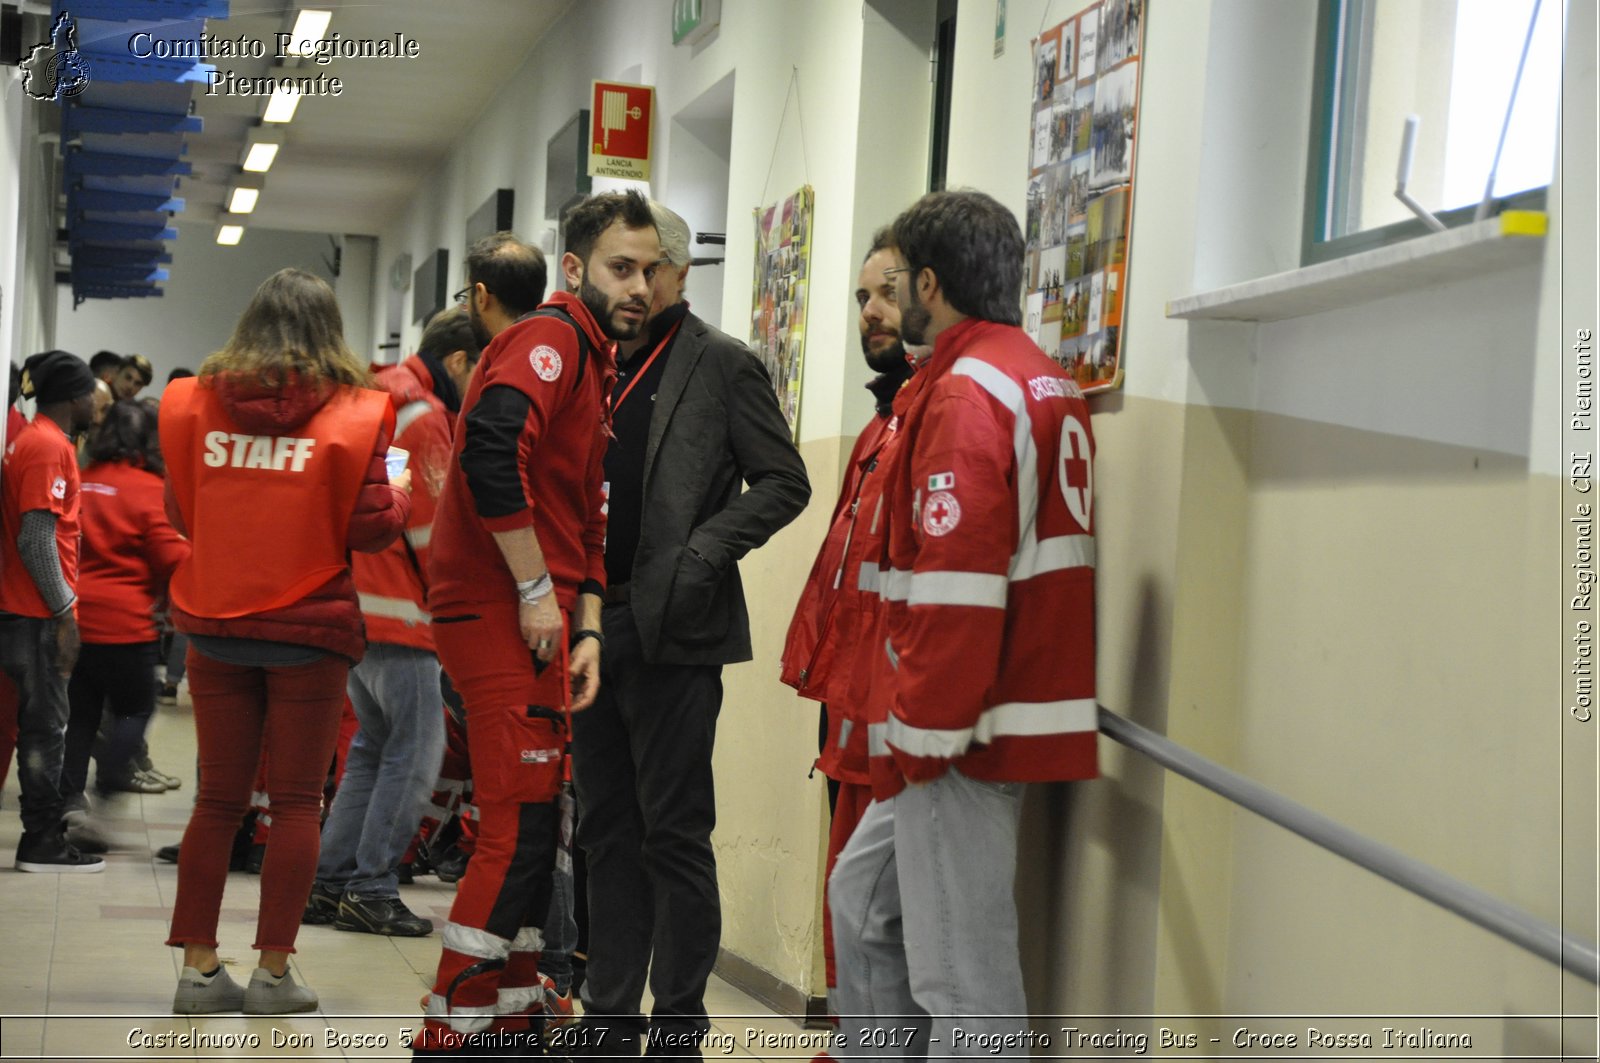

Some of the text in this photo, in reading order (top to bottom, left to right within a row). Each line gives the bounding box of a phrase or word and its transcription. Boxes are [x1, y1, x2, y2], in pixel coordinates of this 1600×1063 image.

[606, 158, 632, 168] LANCIA
[595, 166, 643, 178] ANTINCENDIO
[203, 430, 316, 472] STAFF
